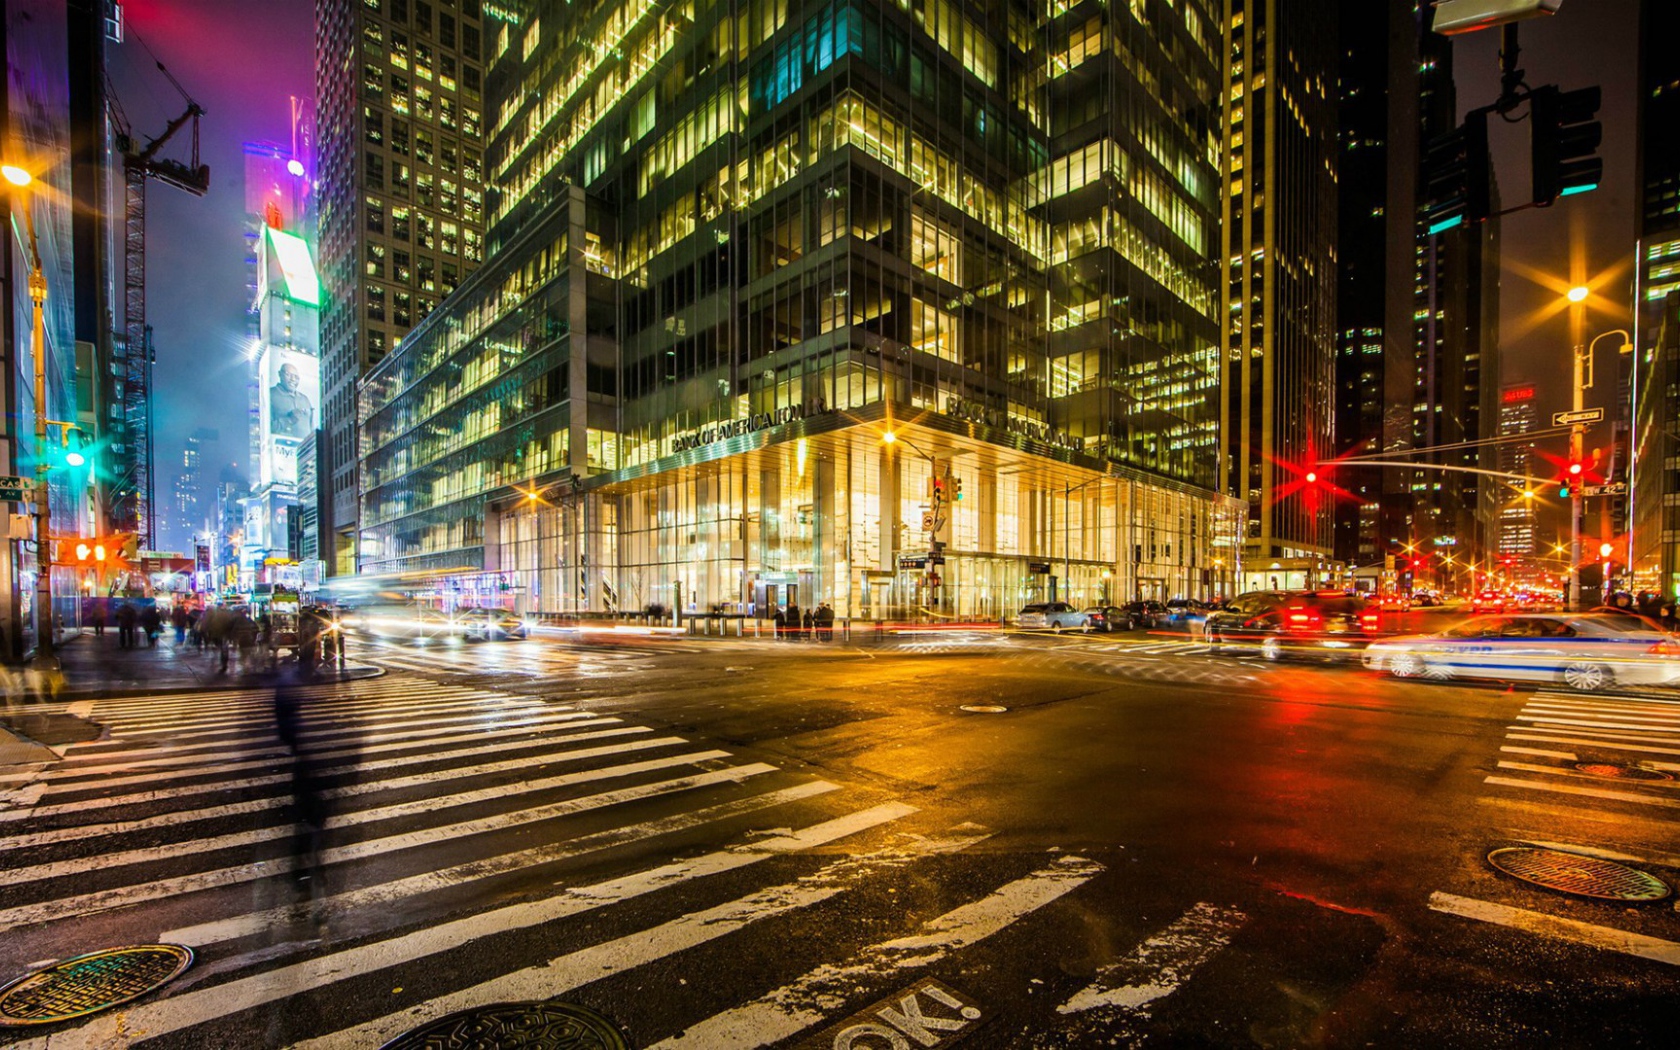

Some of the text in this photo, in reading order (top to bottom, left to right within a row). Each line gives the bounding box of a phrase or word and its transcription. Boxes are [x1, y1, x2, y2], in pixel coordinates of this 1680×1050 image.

[672, 432, 701, 452] BANK
[702, 428, 718, 445] OF
[716, 412, 774, 441] AMERICA
[1603, 486, 1617, 494] 42
